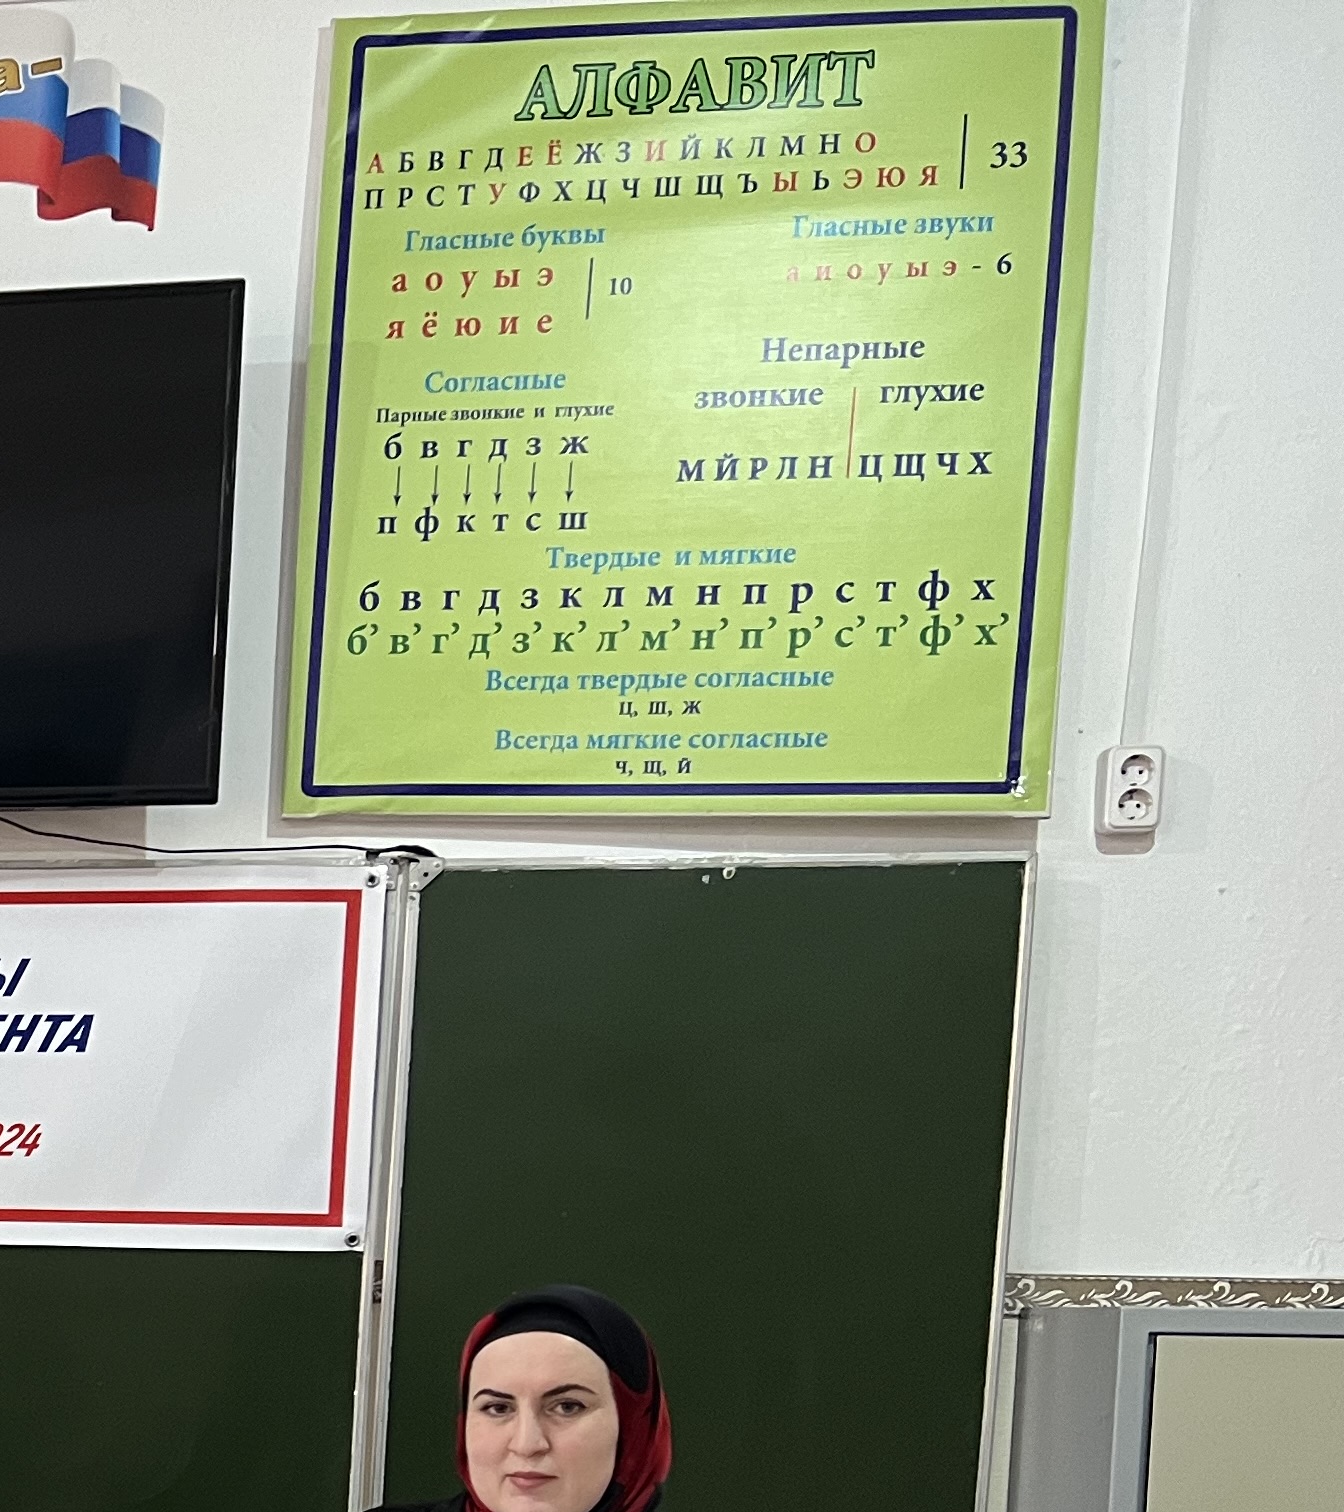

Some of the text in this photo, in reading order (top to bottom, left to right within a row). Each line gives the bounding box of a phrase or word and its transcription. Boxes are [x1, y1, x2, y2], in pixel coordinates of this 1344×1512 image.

[514, 50, 875, 121] АЛФАВИТ
[366, 132, 876, 174] А Б В Г Д Е Ё Ж З И Й К Л М Н О
[990, 141, 1027, 169] 33
[363, 165, 939, 210] П Р С Т У Ф Х Ц Ч Ш Щ Ъ Ы Ь Э Ю Я
[404, 223, 606, 253] Гласные буквы
[792, 215, 994, 240] Гласные звуки
[392, 268, 553, 298] а о у ы э
[609, 277, 632, 296] 10
[385, 311, 552, 339] я ё ю и е
[761, 338, 925, 369] Непарные
[425, 371, 566, 393] Согласные
[694, 384, 984, 411] звонкие глухие
[376, 405, 614, 427] Парные звонкие и глухие
[546, 547, 796, 574] Твердые и мягкие
[484, 670, 834, 696] Всегда твердые согласные
[494, 729, 828, 753] Всегда мягкие согласные
